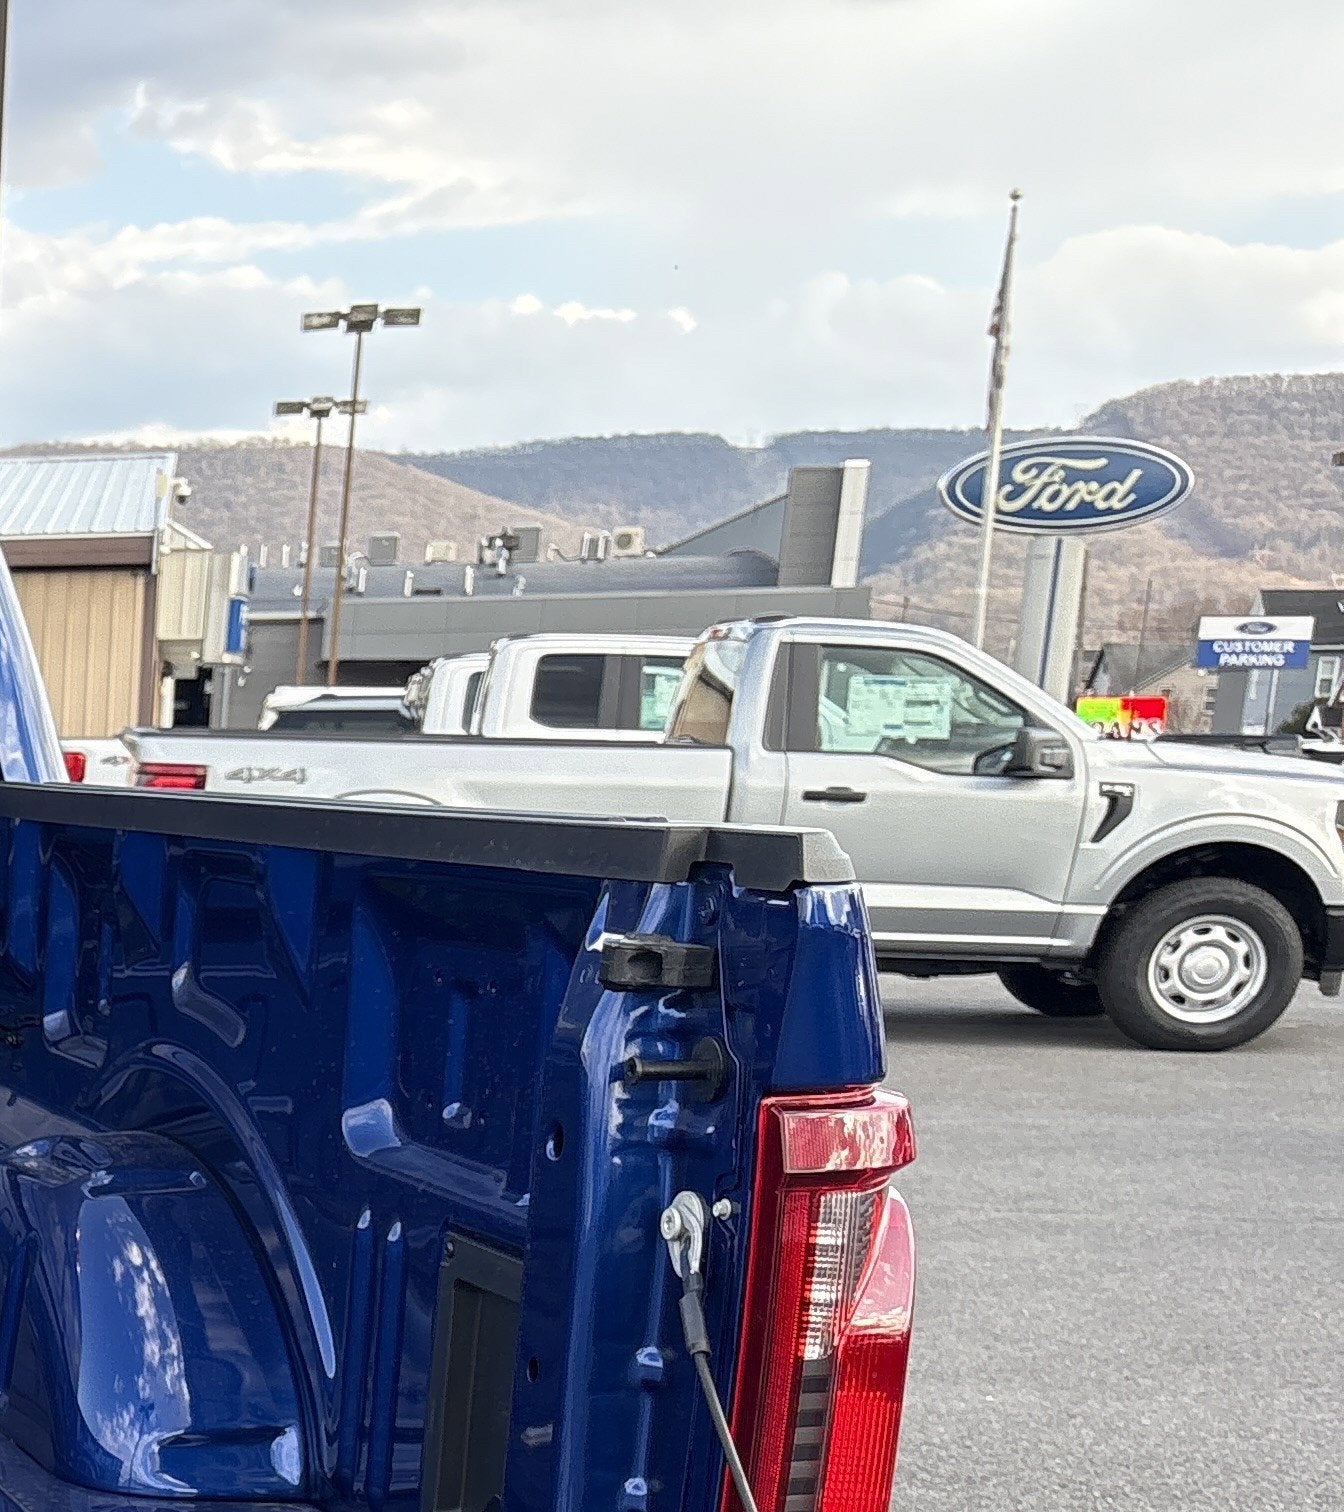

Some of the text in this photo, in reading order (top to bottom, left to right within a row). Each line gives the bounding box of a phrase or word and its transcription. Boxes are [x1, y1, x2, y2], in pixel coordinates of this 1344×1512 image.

[995, 456, 1144, 513] Ford
[1212, 641, 1295, 653] CUSTOMER
[1218, 653, 1286, 667] PARKING
